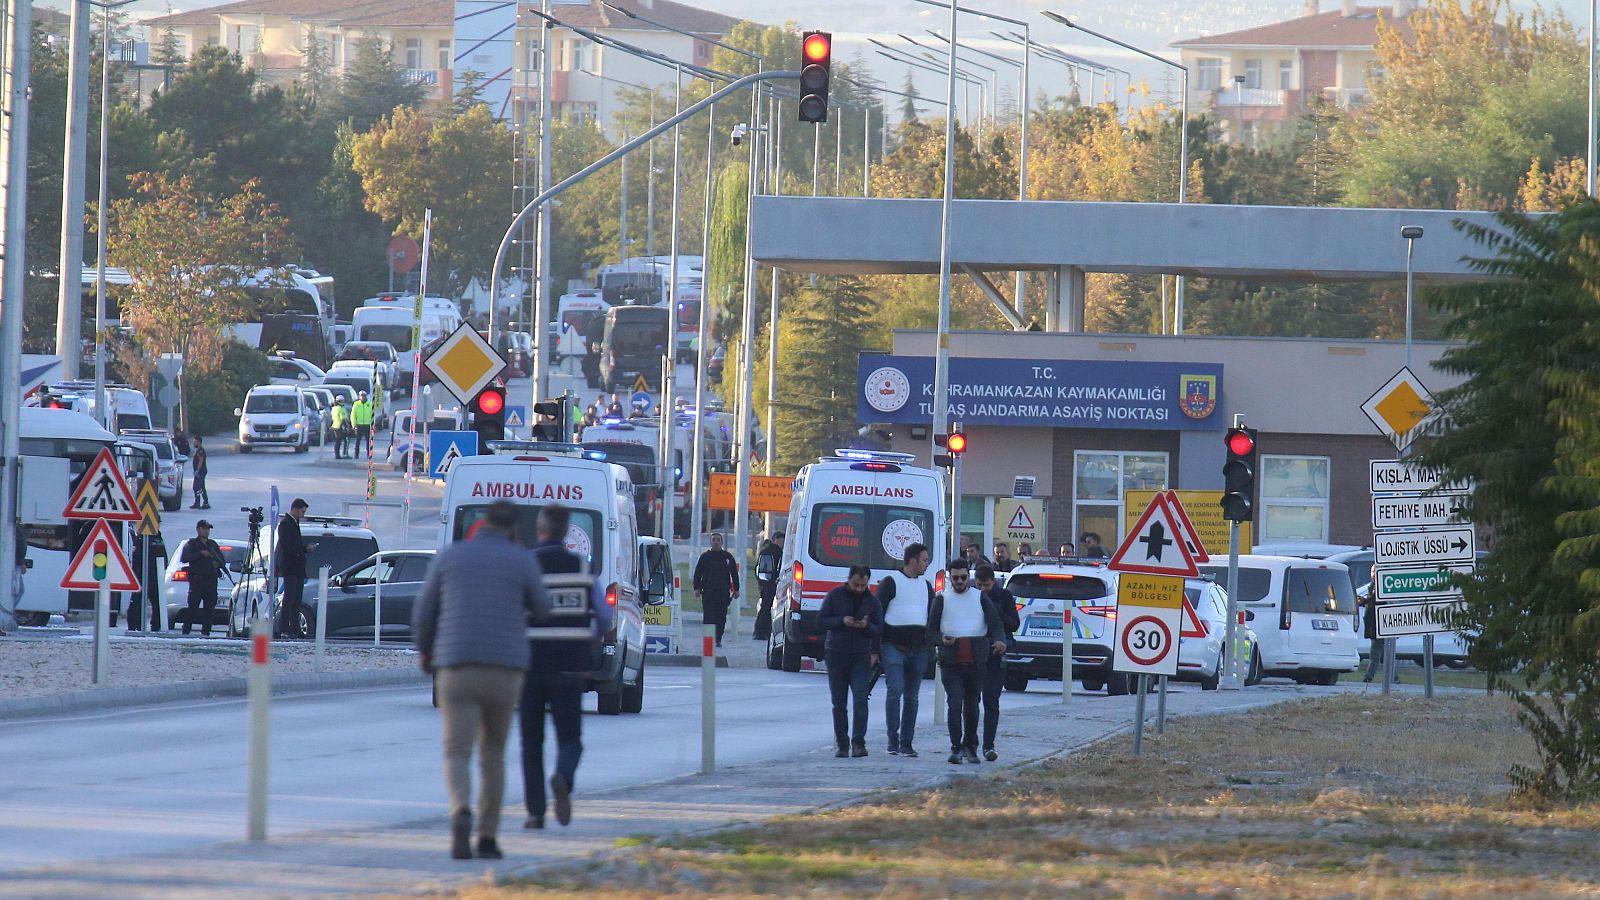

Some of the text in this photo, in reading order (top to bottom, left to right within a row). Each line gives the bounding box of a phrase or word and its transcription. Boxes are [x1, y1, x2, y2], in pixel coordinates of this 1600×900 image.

[1031, 366, 1057, 379] T.C.
[922, 383, 1166, 402] KHRAMANKAZAN KAYMAKAMLIĞI
[919, 402, 1169, 422] TUAŞ JANDARMA ASAYİŞ NOKTASI
[1376, 468, 1412, 486] KIŞLA
[471, 481, 584, 501] AMBULANS
[830, 484, 915, 499] AMBULANS
[1007, 531, 1035, 541] YAVAŞ
[1423, 535, 1449, 554] ÜSSÜ
[1131, 591, 1172, 601] BÖLGESİ
[1132, 628, 1161, 651] 30
